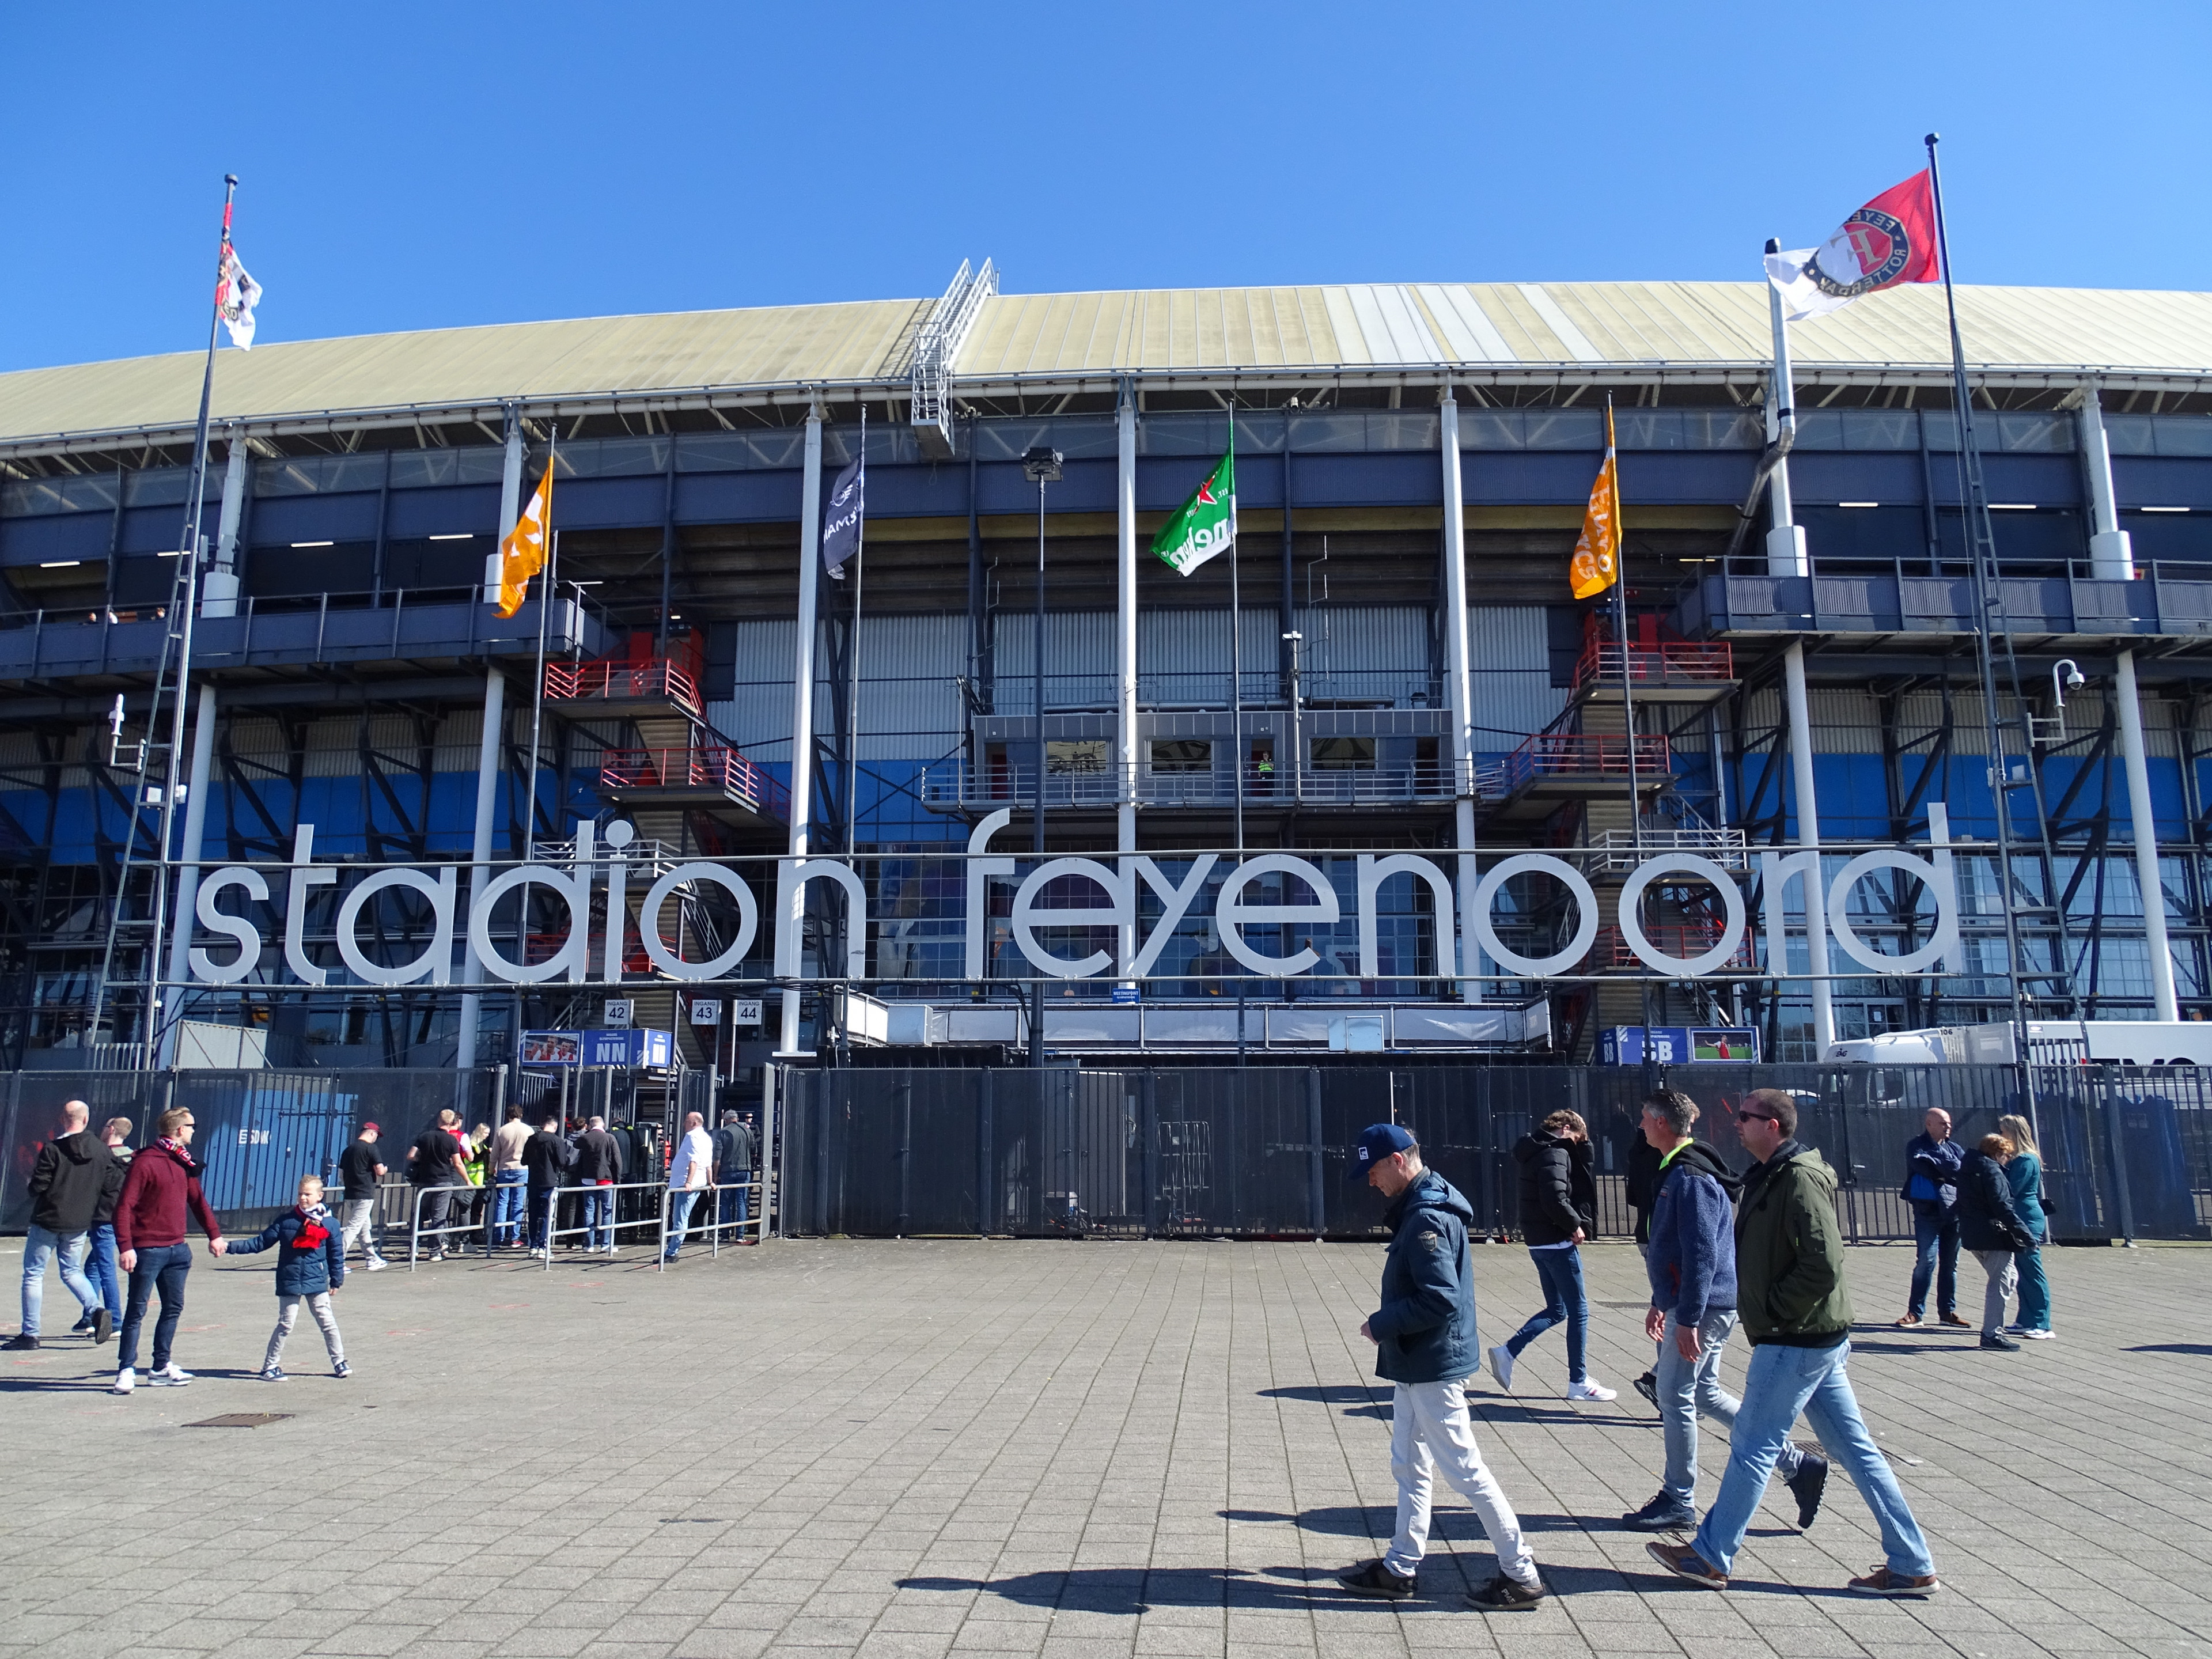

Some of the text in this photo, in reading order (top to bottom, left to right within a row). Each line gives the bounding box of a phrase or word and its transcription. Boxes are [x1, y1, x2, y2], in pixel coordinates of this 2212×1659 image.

[188, 802, 1961, 986] stadion feyenoord
[609, 1007, 624, 1018] 42
[696, 1007, 713, 1018] 43
[740, 1007, 757, 1018] 44
[596, 1043, 626, 1062] NN
[1604, 1042, 1613, 1063] BB
